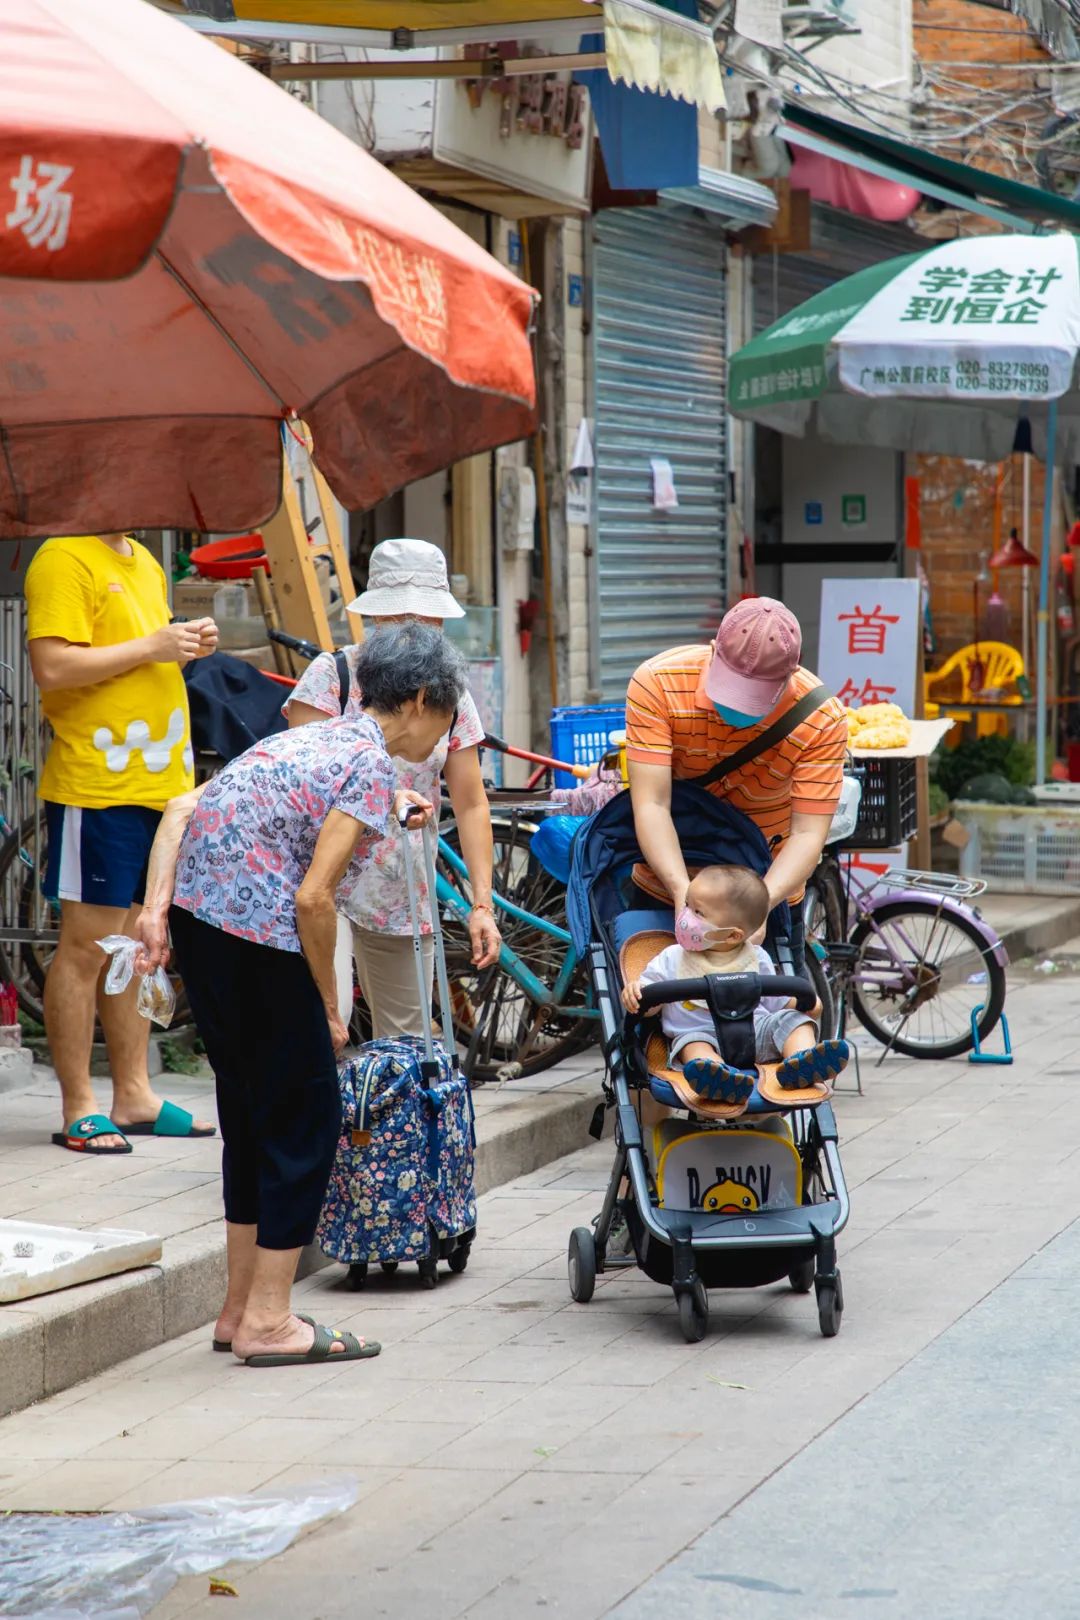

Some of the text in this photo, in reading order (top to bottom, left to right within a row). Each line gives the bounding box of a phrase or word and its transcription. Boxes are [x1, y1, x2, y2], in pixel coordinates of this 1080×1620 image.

[6, 154, 73, 252] 场
[919, 266, 1062, 295] 学会计
[899, 296, 1047, 325] 到恒企
